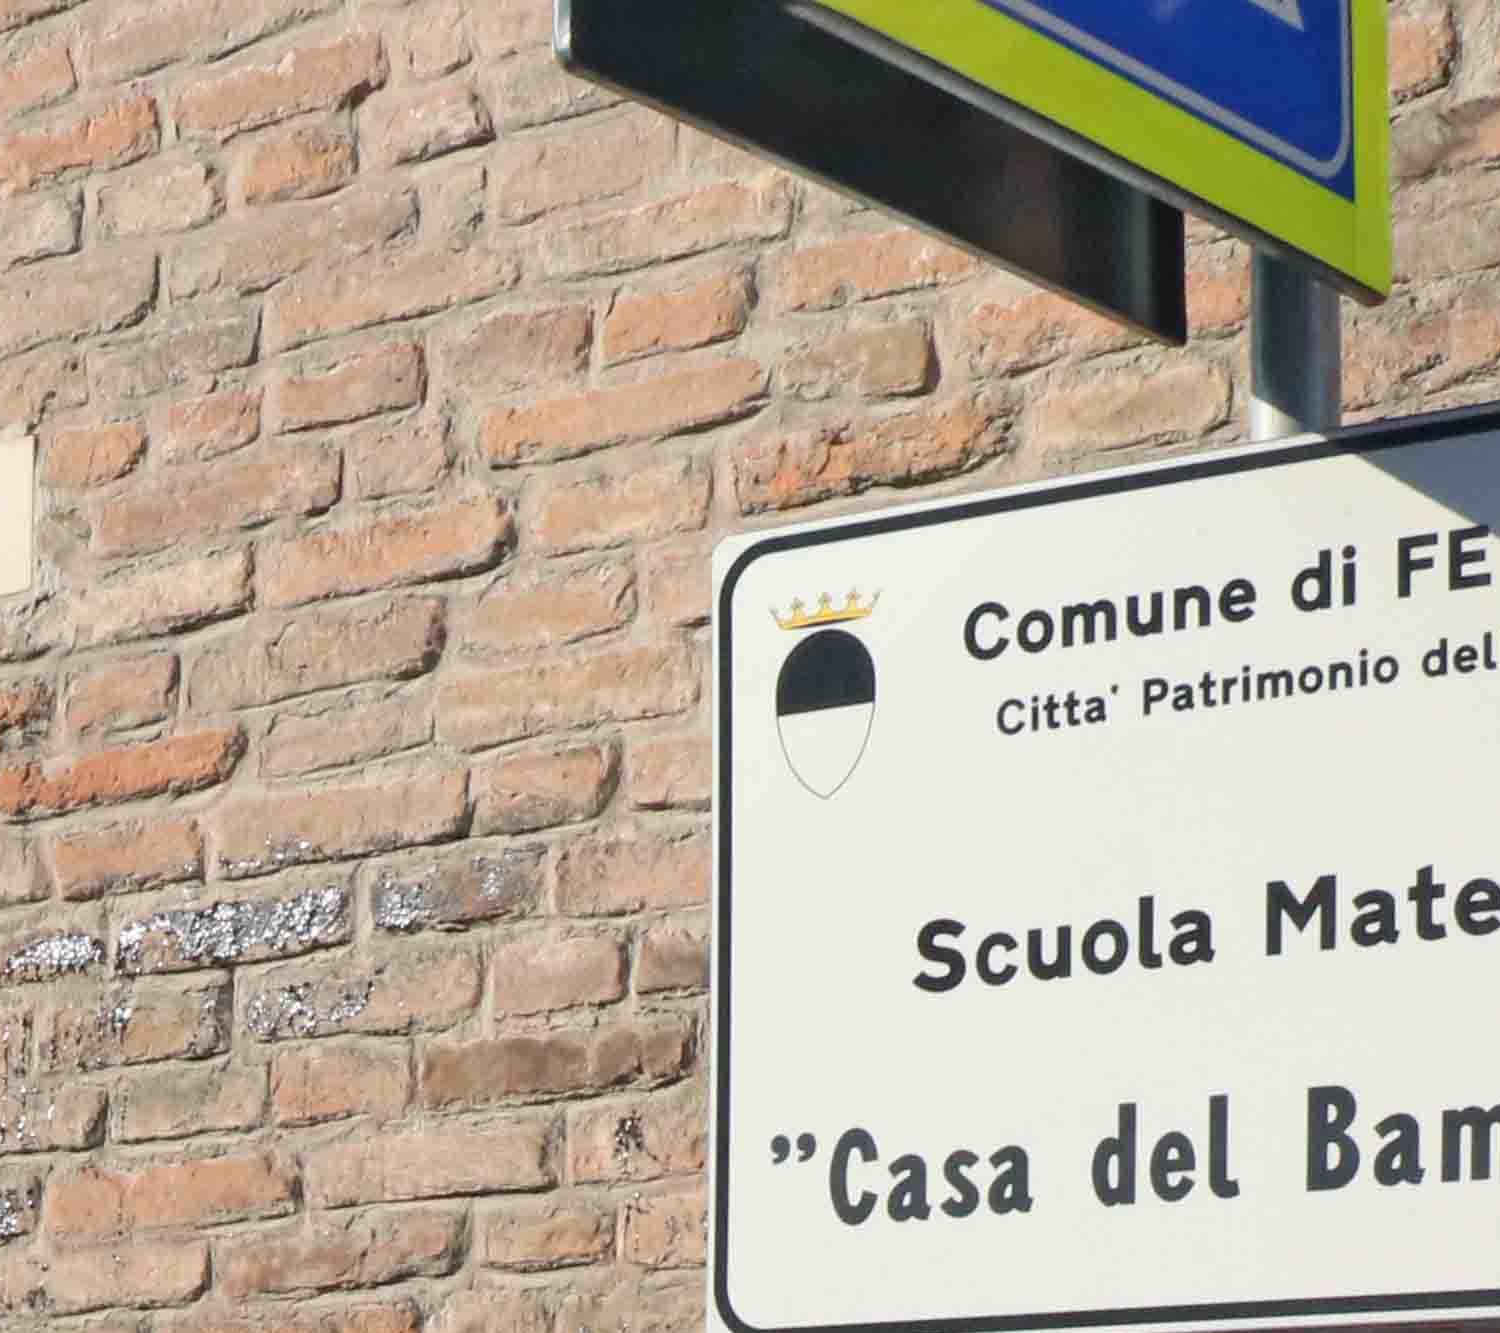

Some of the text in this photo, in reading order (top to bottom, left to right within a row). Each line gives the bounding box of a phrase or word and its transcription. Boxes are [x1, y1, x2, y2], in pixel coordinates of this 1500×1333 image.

[964, 579, 1256, 660] Comune
[1291, 545, 1356, 612] di
[997, 683, 1119, 735] Citta'
[1144, 648, 1399, 715] Patrimonio
[913, 896, 1215, 992] Scuola
[1092, 1095, 1240, 1207] del
